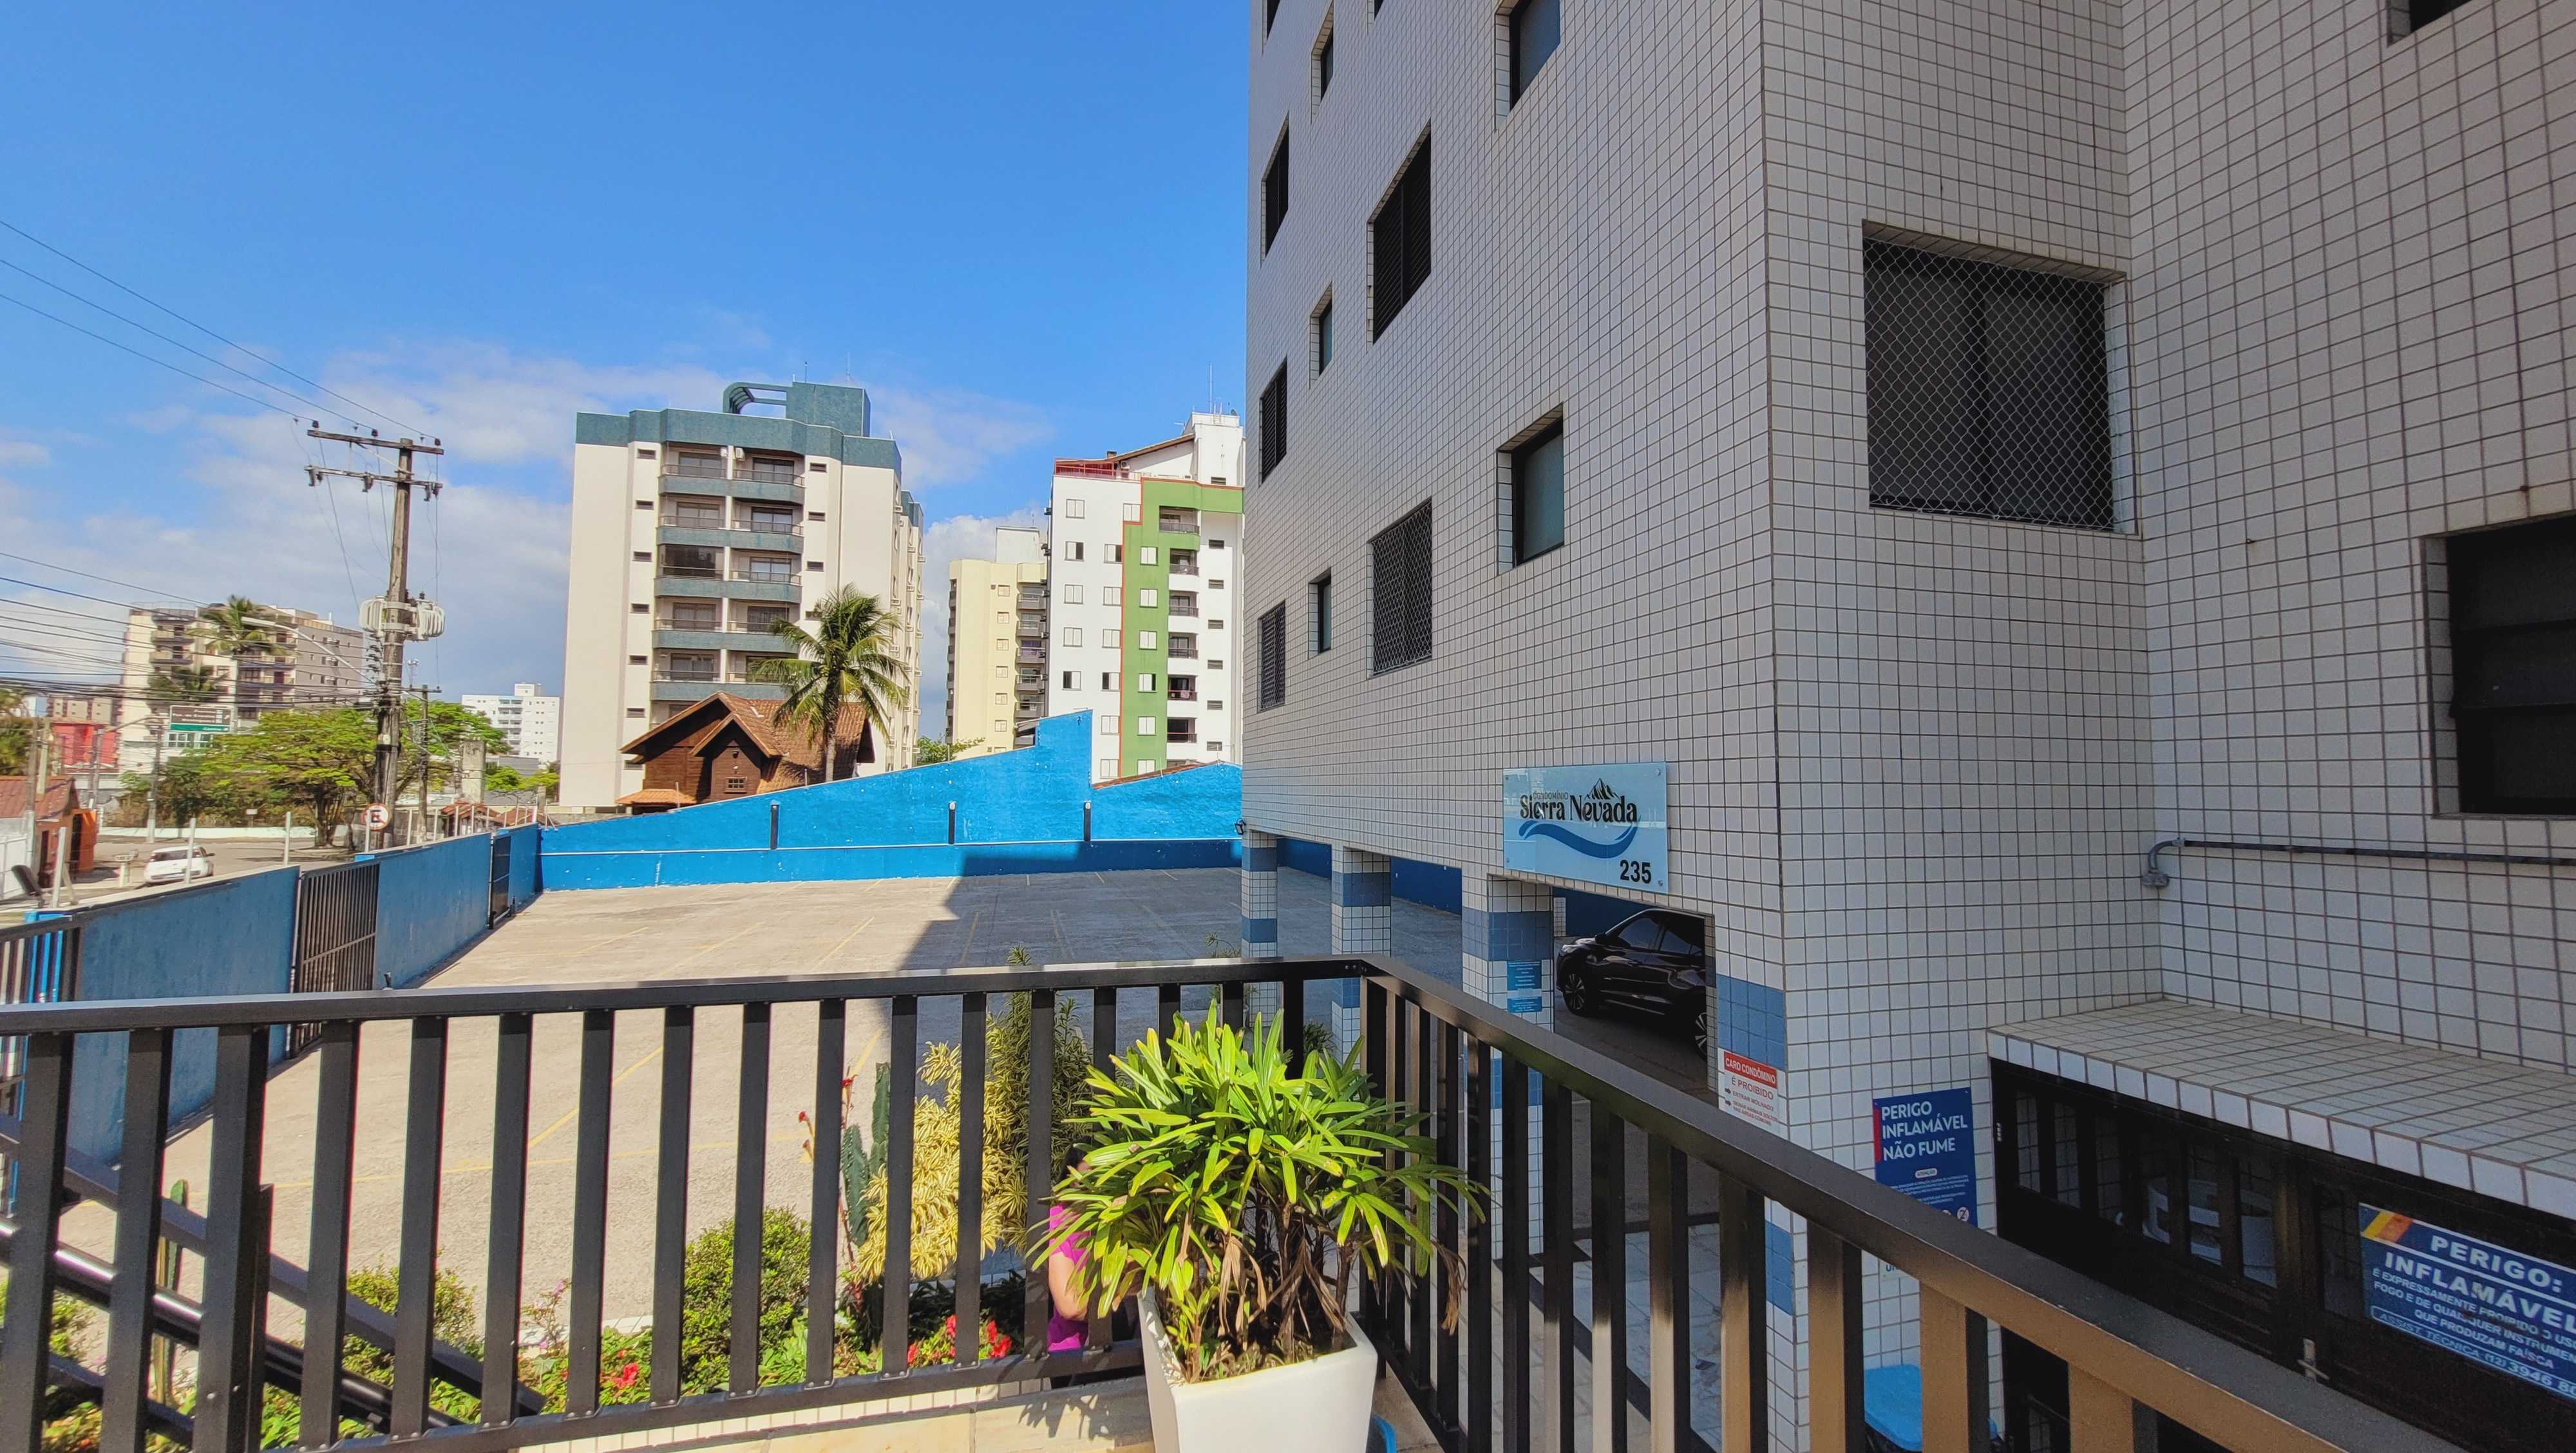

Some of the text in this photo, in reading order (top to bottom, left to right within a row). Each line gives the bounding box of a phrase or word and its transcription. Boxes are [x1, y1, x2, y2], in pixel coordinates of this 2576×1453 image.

[1520, 795, 1638, 822] Sierra Nevada
[1620, 859, 1652, 884] 235
[1726, 1058, 1776, 1083] CARO CONDÔMINO
[1731, 1075, 1774, 1099] É PROIBIDO
[1881, 1100, 1932, 1121] PERIGO
[1882, 1112, 1968, 1139] INFLAMÁVEL
[1883, 1137, 1956, 1161] NÃO FUME
[2430, 1235, 2562, 1293] PERIGO:
[2372, 1267, 2380, 1277] É
[2382, 1271, 2477, 1313] EXPRESSAMENTE
[2385, 1251, 2576, 1334] INFLAMÁVEL
[2374, 1281, 2404, 1298] FOGO
[2406, 1293, 2414, 1302] E
[2416, 1296, 2432, 1309] DE
[2432, 1303, 2501, 1335] QUAIQUER
[2415, 1309, 2438, 1325] QUE
[2440, 1320, 2505, 1350] PRODUZAM
[2508, 1362, 2553, 1385] 3946
